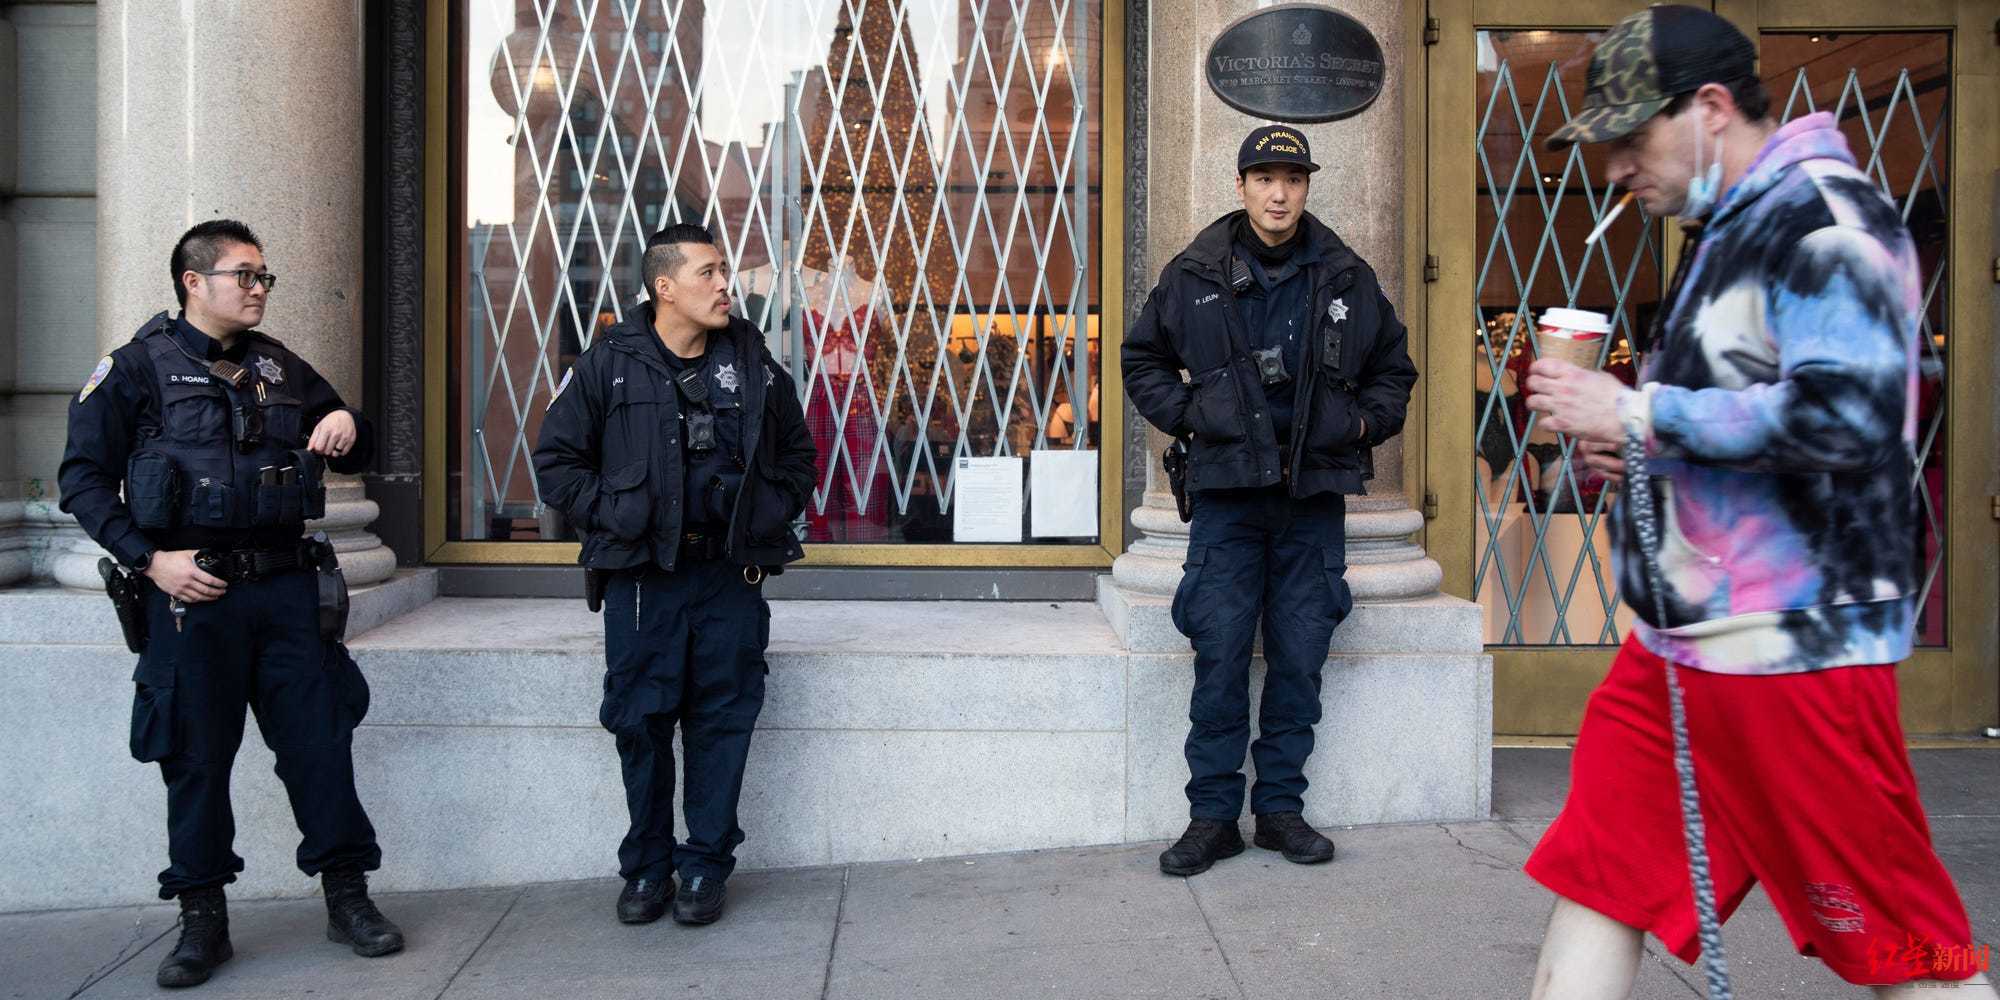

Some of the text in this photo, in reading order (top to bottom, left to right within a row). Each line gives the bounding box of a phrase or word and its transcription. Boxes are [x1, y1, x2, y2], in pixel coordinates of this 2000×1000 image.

[1320, 52, 1380, 75] SECRET
[1255, 136, 1269, 151] SAN
[1271, 144, 1298, 154] POLICE
[182, 375, 209, 384] HOANG
